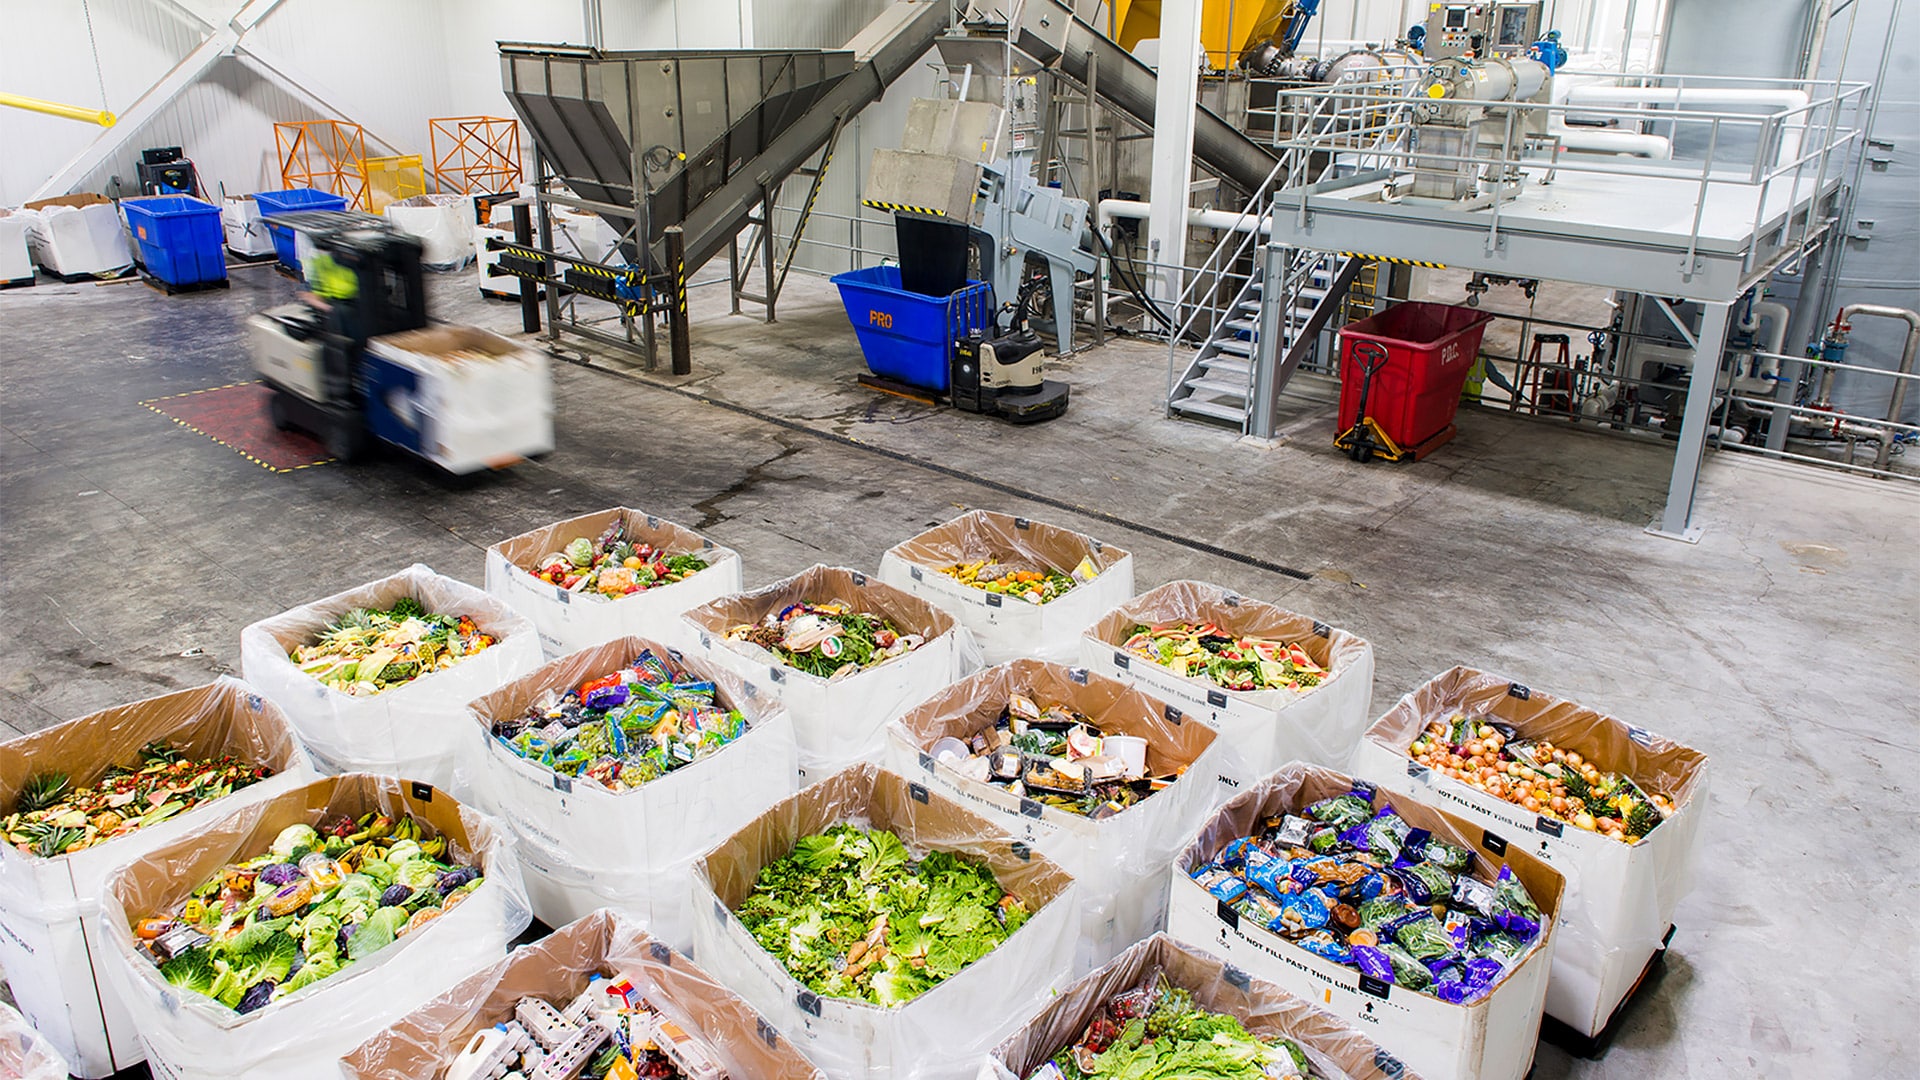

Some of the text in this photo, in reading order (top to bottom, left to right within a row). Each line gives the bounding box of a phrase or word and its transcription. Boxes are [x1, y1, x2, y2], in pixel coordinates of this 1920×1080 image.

[869, 309, 893, 329] PRO
[1160, 685, 1175, 694] PAST
[1177, 691, 1191, 701] THIS
[1192, 697, 1206, 706] LINE
[967, 793, 984, 804] PAST
[986, 800, 1001, 811] THIS
[1003, 807, 1019, 817] LINE
[1453, 796, 1469, 807] FILL
[1471, 804, 1491, 816] PAST
[1515, 821, 1534, 833] LINE
[1234, 929, 1358, 995] DO NOT FILL PAST THIS LINE
[1358, 1011, 1380, 1025] LOCK
